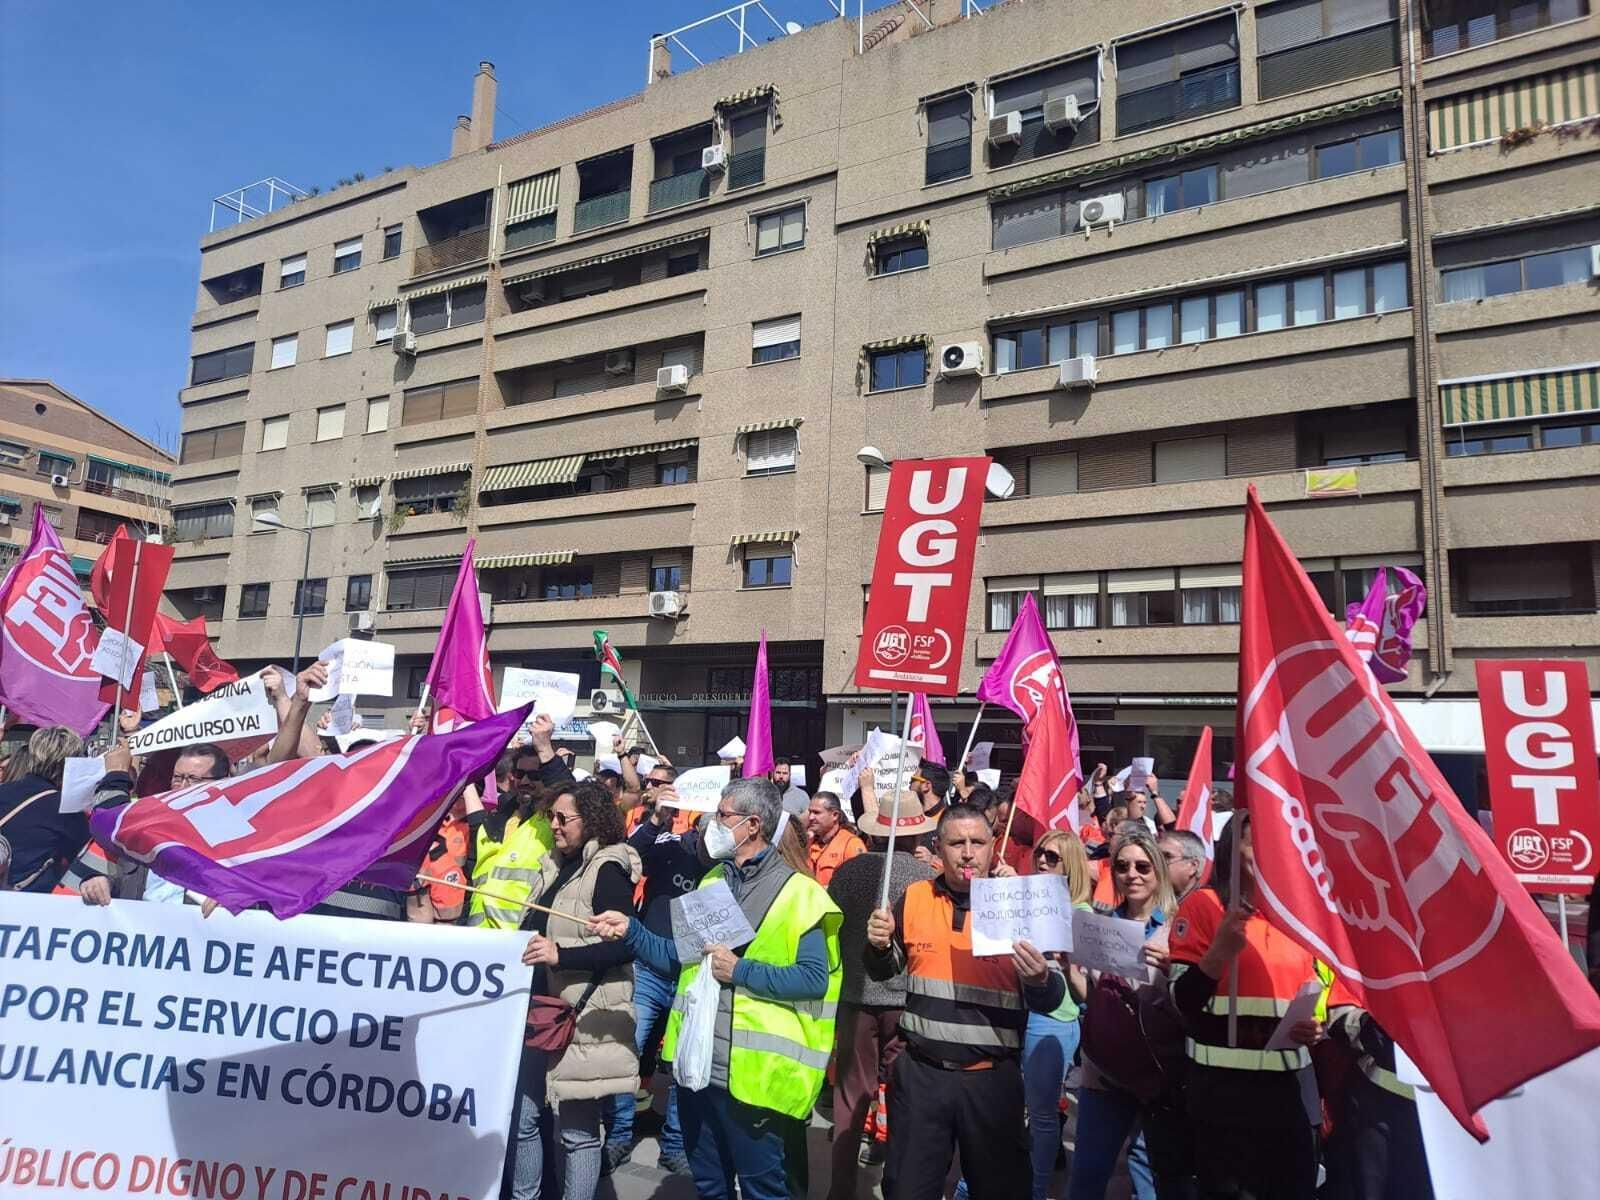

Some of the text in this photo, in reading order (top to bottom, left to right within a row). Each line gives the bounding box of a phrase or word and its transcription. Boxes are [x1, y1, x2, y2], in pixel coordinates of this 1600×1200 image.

[893, 466, 968, 623] UGT
[879, 631, 908, 650] UGT
[913, 634, 936, 648] FSP
[692, 692, 753, 701] PRESIDENT
[155, 718, 235, 744] CONCURSO
[236, 714, 260, 731] YA!
[1501, 670, 1577, 825] UGT
[1282, 660, 1482, 912] UGT
[1512, 835, 1543, 852] UGT
[1550, 837, 1574, 851] FSP
[1012, 926, 1031, 937] NO
[203, 938, 255, 978] DE
[263, 945, 506, 999] AFECTADOS
[0, 983, 404, 1052] POR EL SERVICIO DE
[216, 1061, 270, 1101] EN
[280, 1062, 478, 1127] CÓRDOBA
[127, 1154, 246, 1200] DIGNO
[254, 1165, 277, 1200] Y
[283, 1169, 328, 1200] DE
